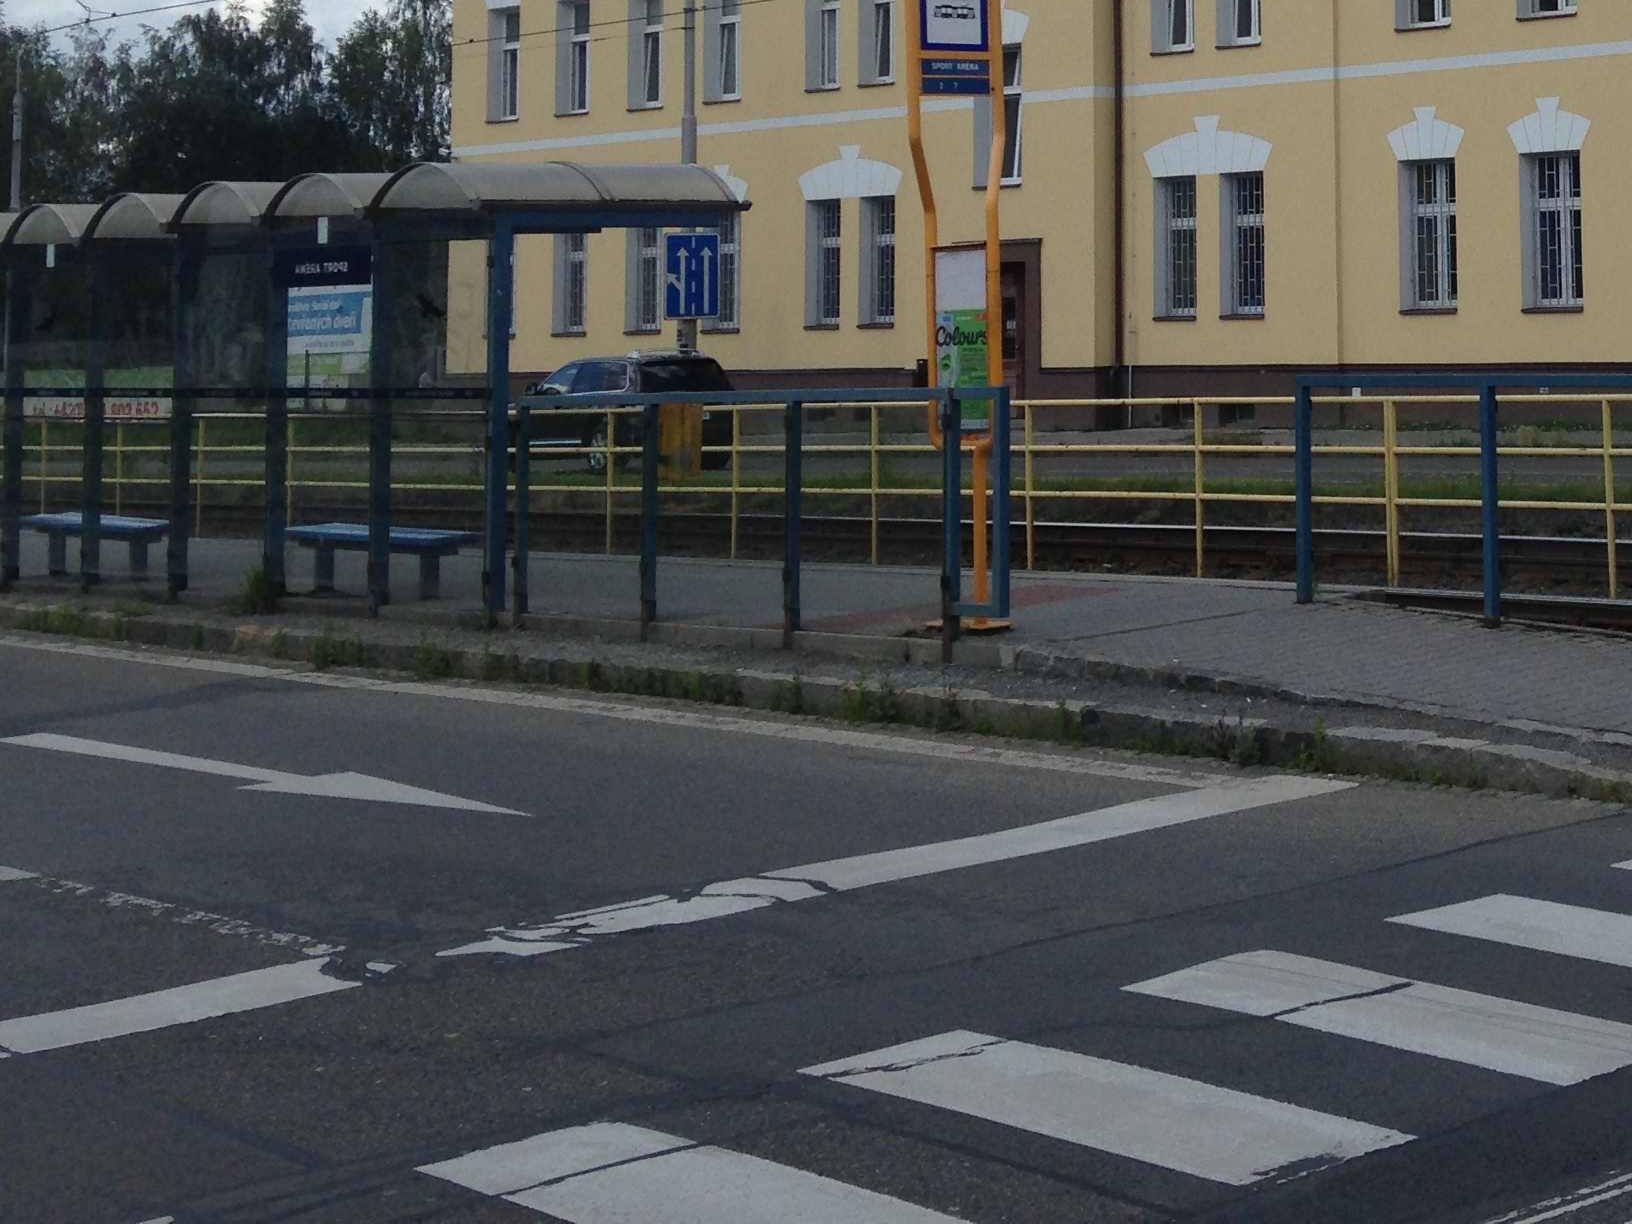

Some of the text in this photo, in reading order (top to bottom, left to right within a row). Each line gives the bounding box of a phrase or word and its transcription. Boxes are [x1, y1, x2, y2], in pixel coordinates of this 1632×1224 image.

[931, 61, 953, 70] SPORT
[939, 81, 944, 90] 2
[936, 325, 987, 347] Colours
